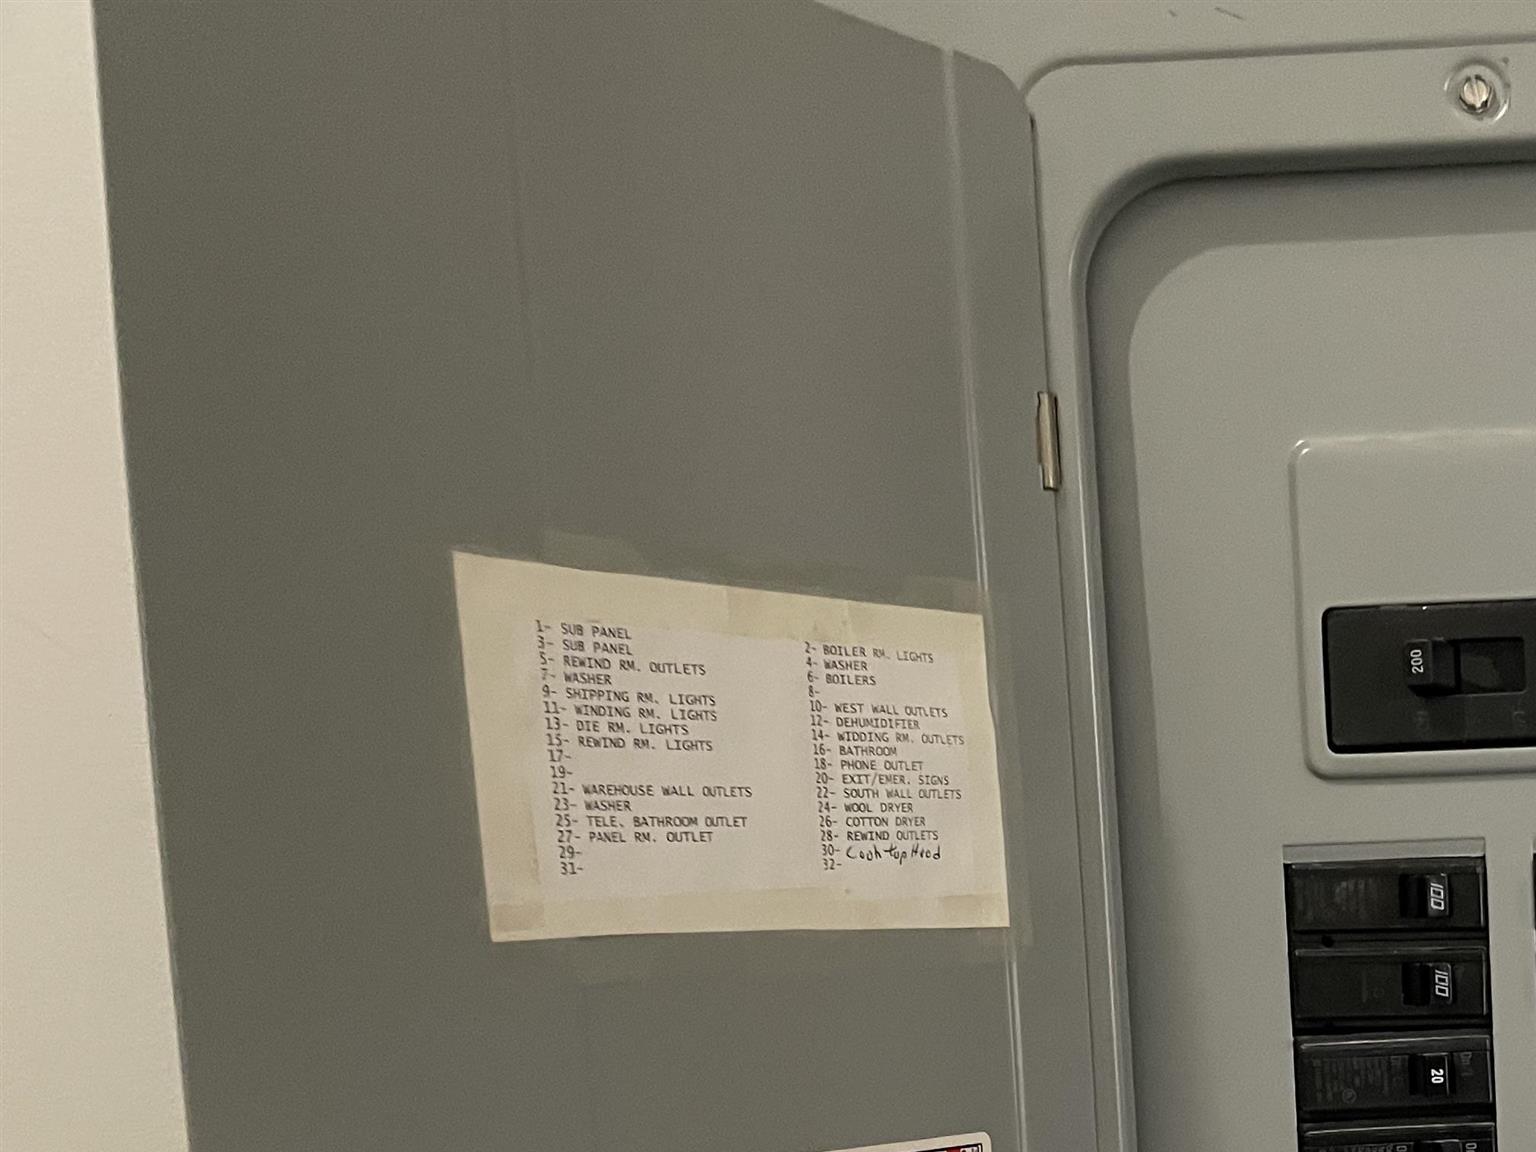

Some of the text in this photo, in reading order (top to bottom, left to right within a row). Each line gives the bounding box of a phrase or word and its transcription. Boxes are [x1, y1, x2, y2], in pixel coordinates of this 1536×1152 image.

[561, 623, 584, 636] SUB
[592, 625, 632, 640] PANEL
[562, 639, 584, 651] SUB
[593, 642, 633, 655] PANEL
[823, 643, 867, 657] BOILER
[897, 650, 934, 663] LIGHTS
[563, 655, 611, 670] REWIND
[649, 661, 706, 675] OUTLETS
[824, 659, 868, 671] WASHER
[1410, 649, 1424, 673] 200
[564, 672, 612, 685] WASHER
[825, 674, 876, 686] BOILERS
[669, 693, 716, 706] LIGHTS
[575, 704, 631, 718] WINDING
[671, 709, 717, 722] LIGHTS
[834, 703, 864, 714] WEST
[872, 704, 899, 716] WALL
[905, 705, 948, 718] OUTLETS
[576, 720, 600, 733] DIE
[640, 723, 689, 736] LIGHTS
[836, 716, 920, 730] DEHUMIDIFIER
[578, 735, 626, 749] REWIND
[666, 739, 713, 751] LIGHTS
[921, 733, 965, 745] OUTLETS
[839, 746, 897, 757] BATHROOM
[841, 760, 877, 771] PHONE
[884, 760, 923, 771] OUTLET
[919, 775, 949, 785] SIGNS
[582, 784, 654, 796] WAREHOUSE
[661, 785, 695, 797] WALL
[703, 786, 752, 798] OUTLETS
[843, 788, 879, 799] SOUTH
[886, 789, 912, 799] WALL
[919, 789, 962, 800] OUTLETS
[584, 800, 632, 812] WASHER
[844, 803, 872, 813] WOOL
[880, 803, 913, 813] DRYER
[633, 816, 698, 827] BATHROOM
[705, 816, 747, 827] OUTLET
[846, 817, 888, 827] COTTON
[896, 816, 926, 827] DRYER
[589, 831, 626, 843] PANEL
[666, 831, 713, 842] OUTLET
[847, 831, 889, 841] REWIND
[896, 830, 938, 841] OUTLETS
[1431, 883, 1444, 910] 100
[1436, 970, 1448, 996] 100
[1431, 1069, 1443, 1083] 20
